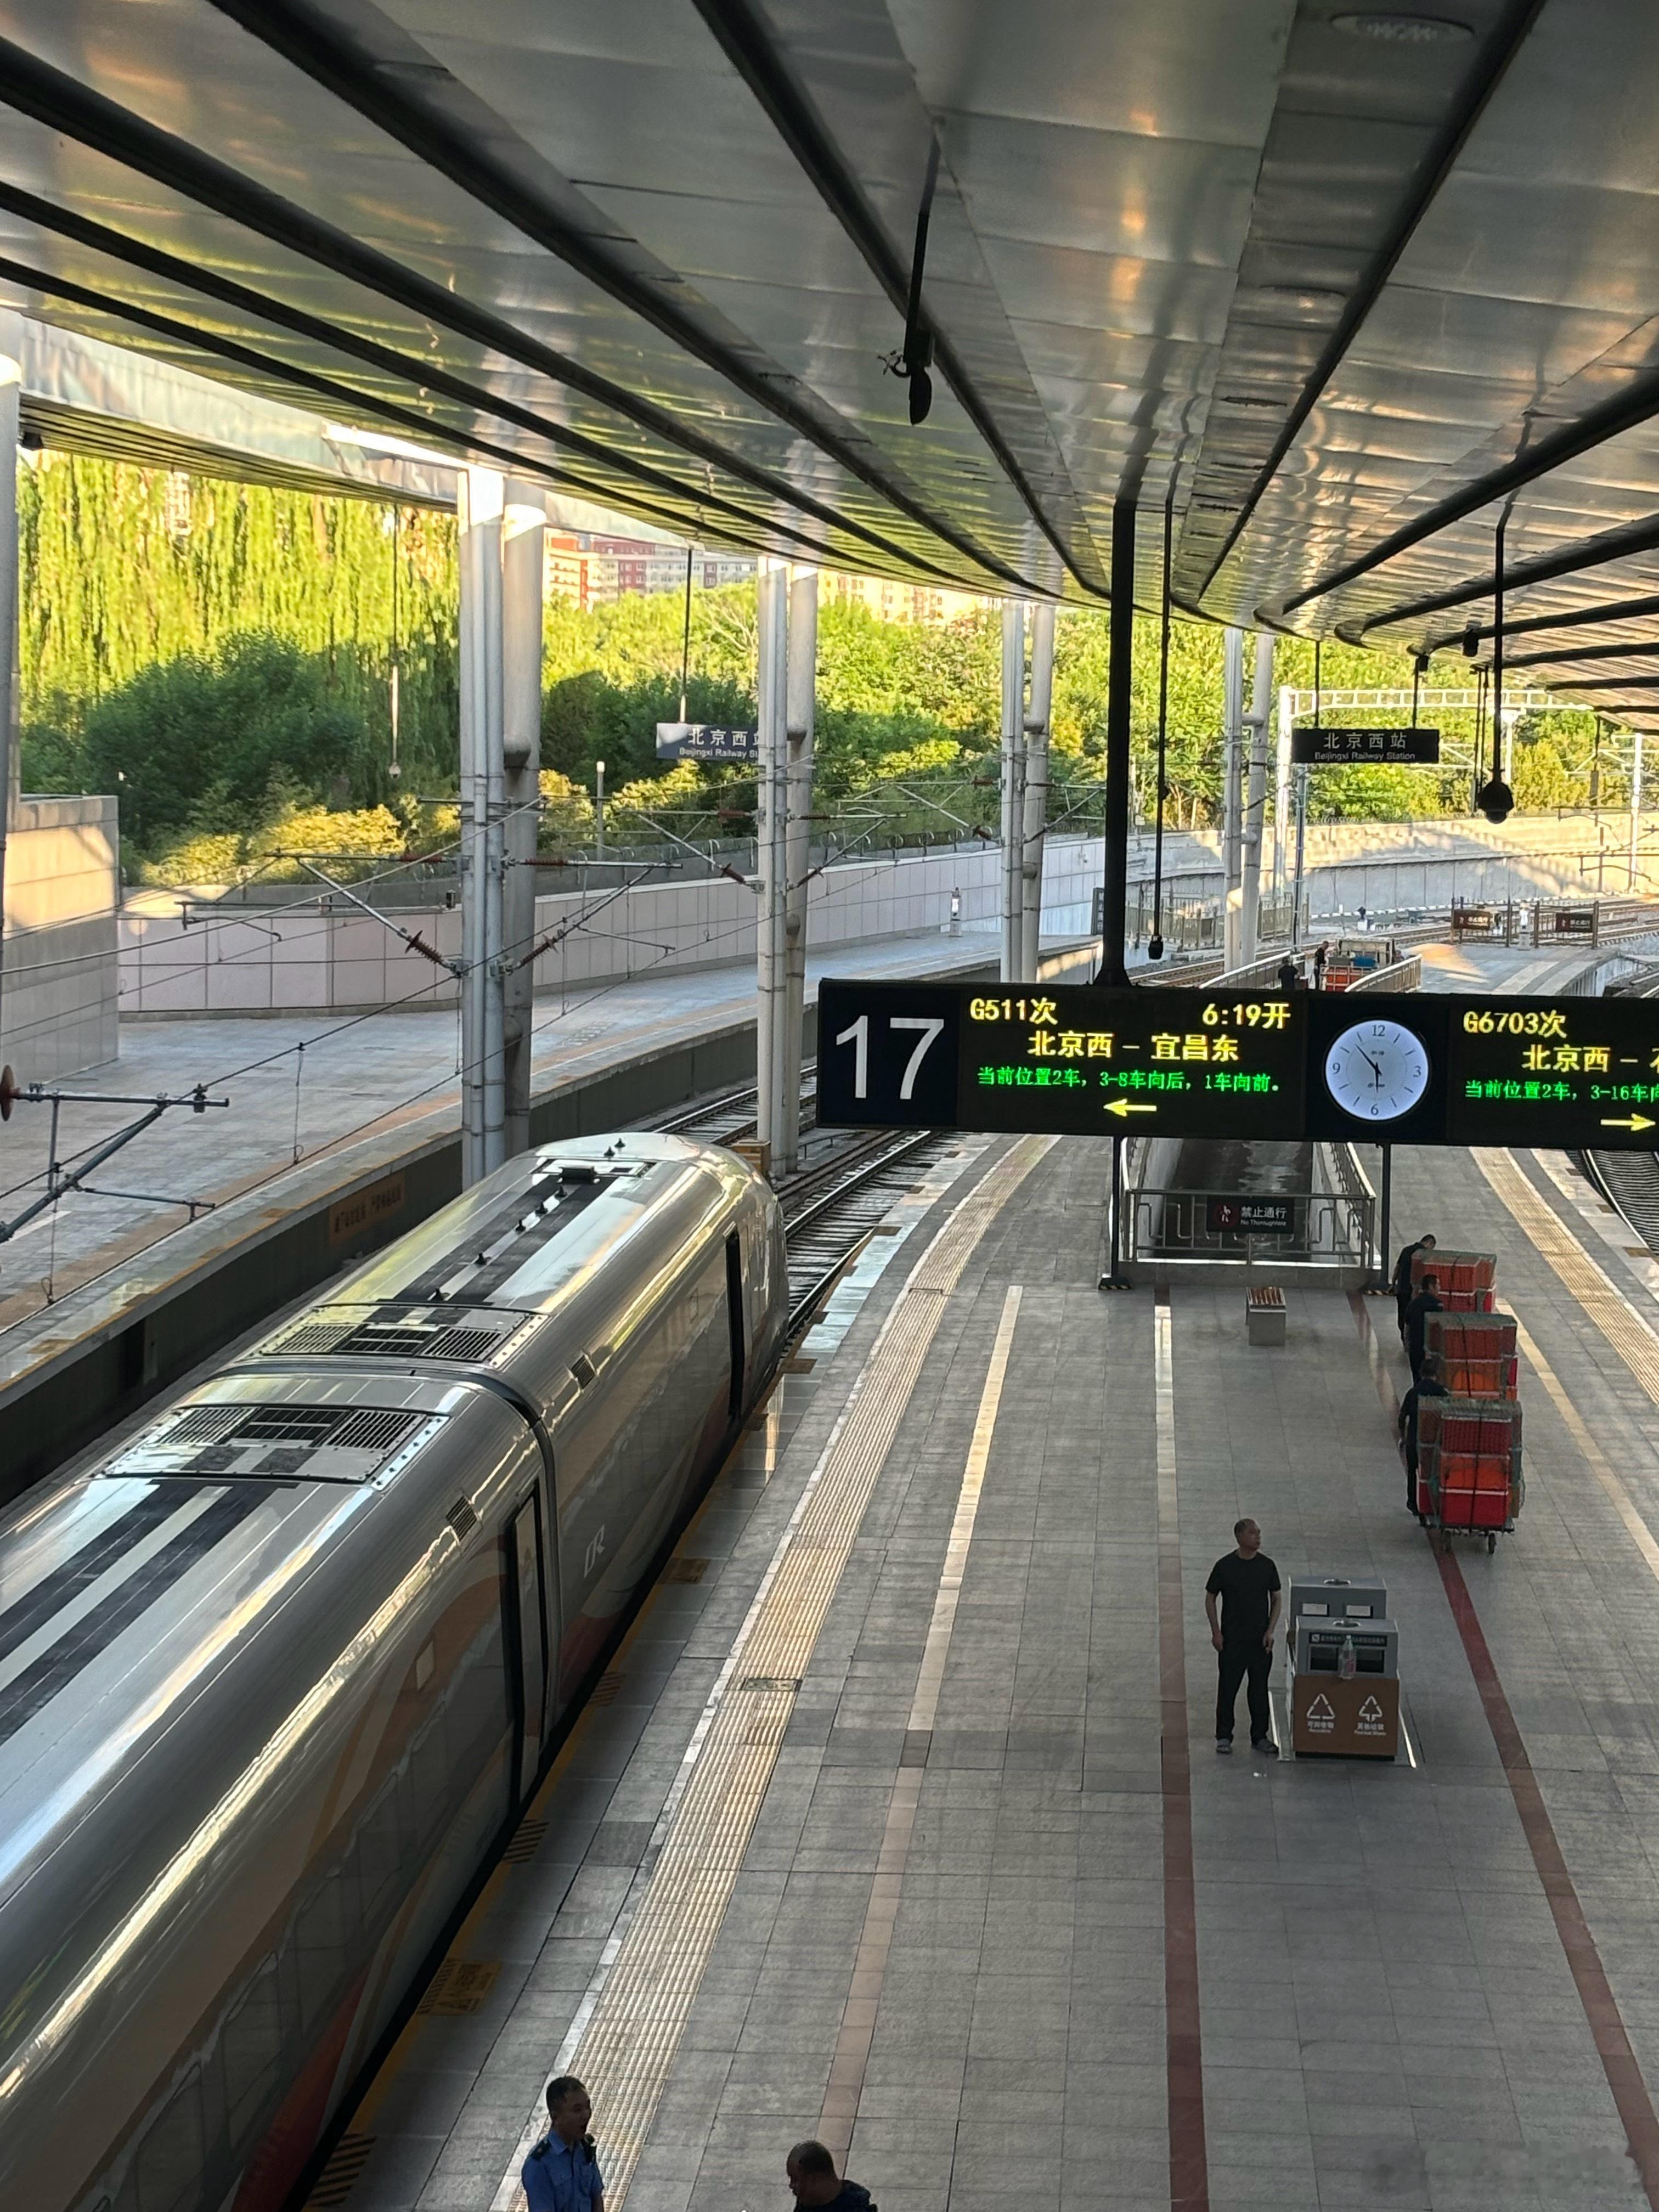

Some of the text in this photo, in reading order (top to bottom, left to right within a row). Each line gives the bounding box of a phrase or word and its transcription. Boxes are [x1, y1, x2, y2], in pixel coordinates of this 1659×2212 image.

[688, 728, 759, 746] 北京西
[1323, 732, 1407, 749] 北京西站
[679, 747, 713, 758] Beijingxi
[715, 748, 747, 758] Railway
[1314, 752, 1415, 761] Beijingxi Railway Station
[970, 997, 1291, 1029] G511次 6:19开
[1372, 1025, 1385, 1036] 12
[1463, 1009, 1567, 1039] G6703次
[836, 1015, 944, 1100] 17
[1332, 1062, 1341, 1075] 9
[1413, 1065, 1421, 1078] 3
[1370, 1103, 1379, 1116] 6
[1240, 1206, 1287, 1219] 禁止通行
